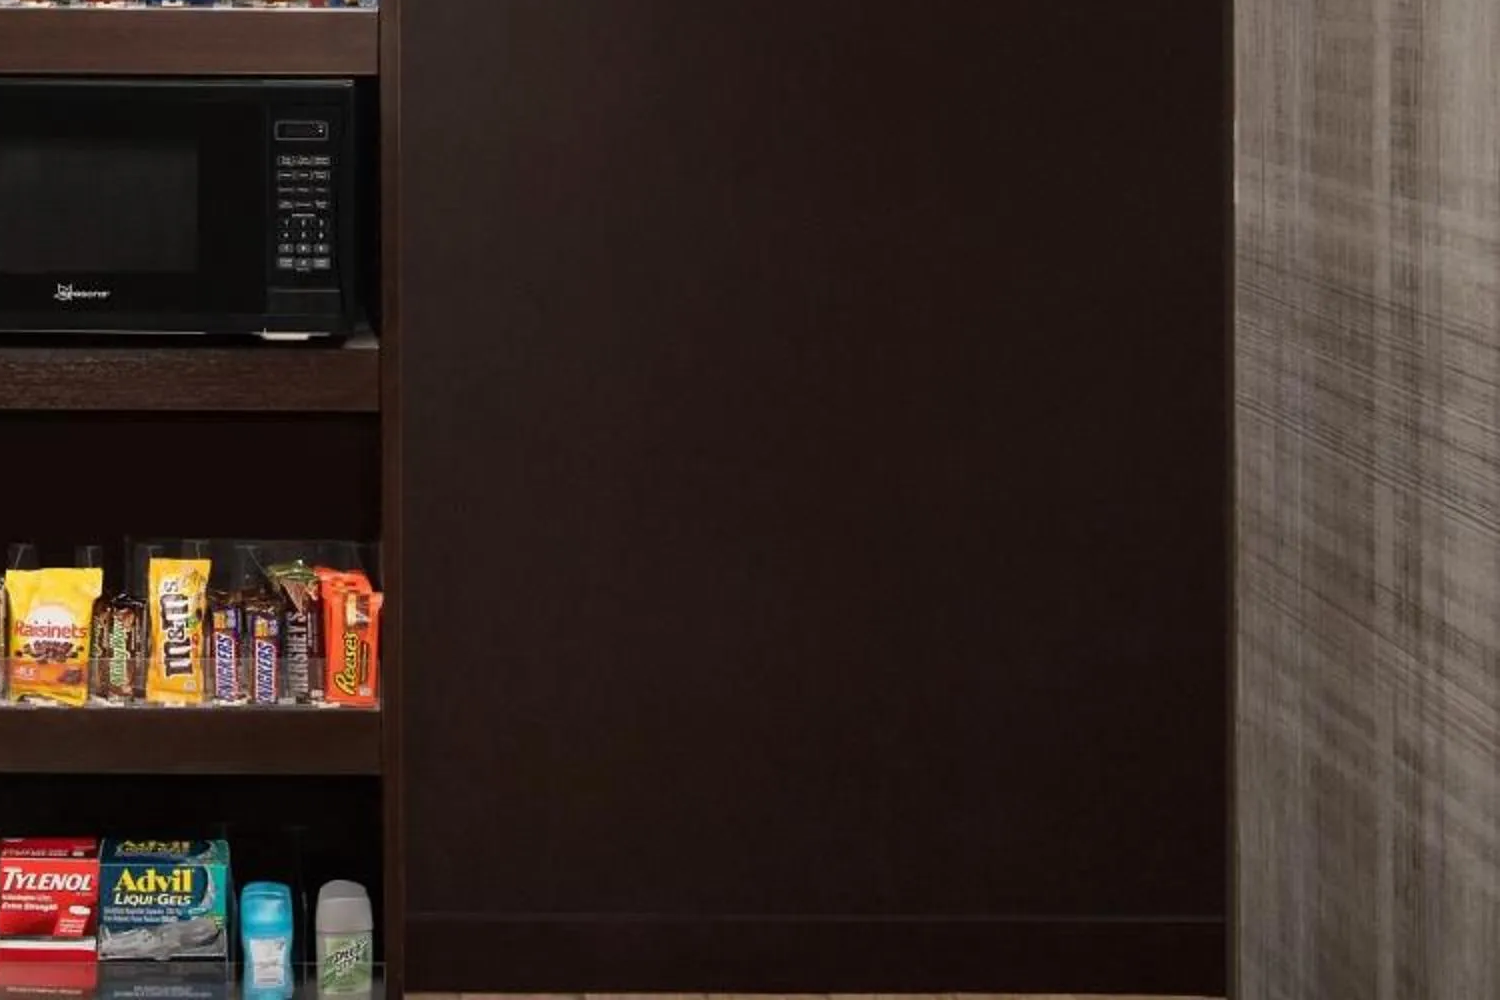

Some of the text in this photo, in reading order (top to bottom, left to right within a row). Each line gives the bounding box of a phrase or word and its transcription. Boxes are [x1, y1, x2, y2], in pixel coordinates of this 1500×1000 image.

[15, 620, 88, 639] Raisinets
[2, 865, 93, 892] TYLENOL
[112, 866, 193, 893] Advil
